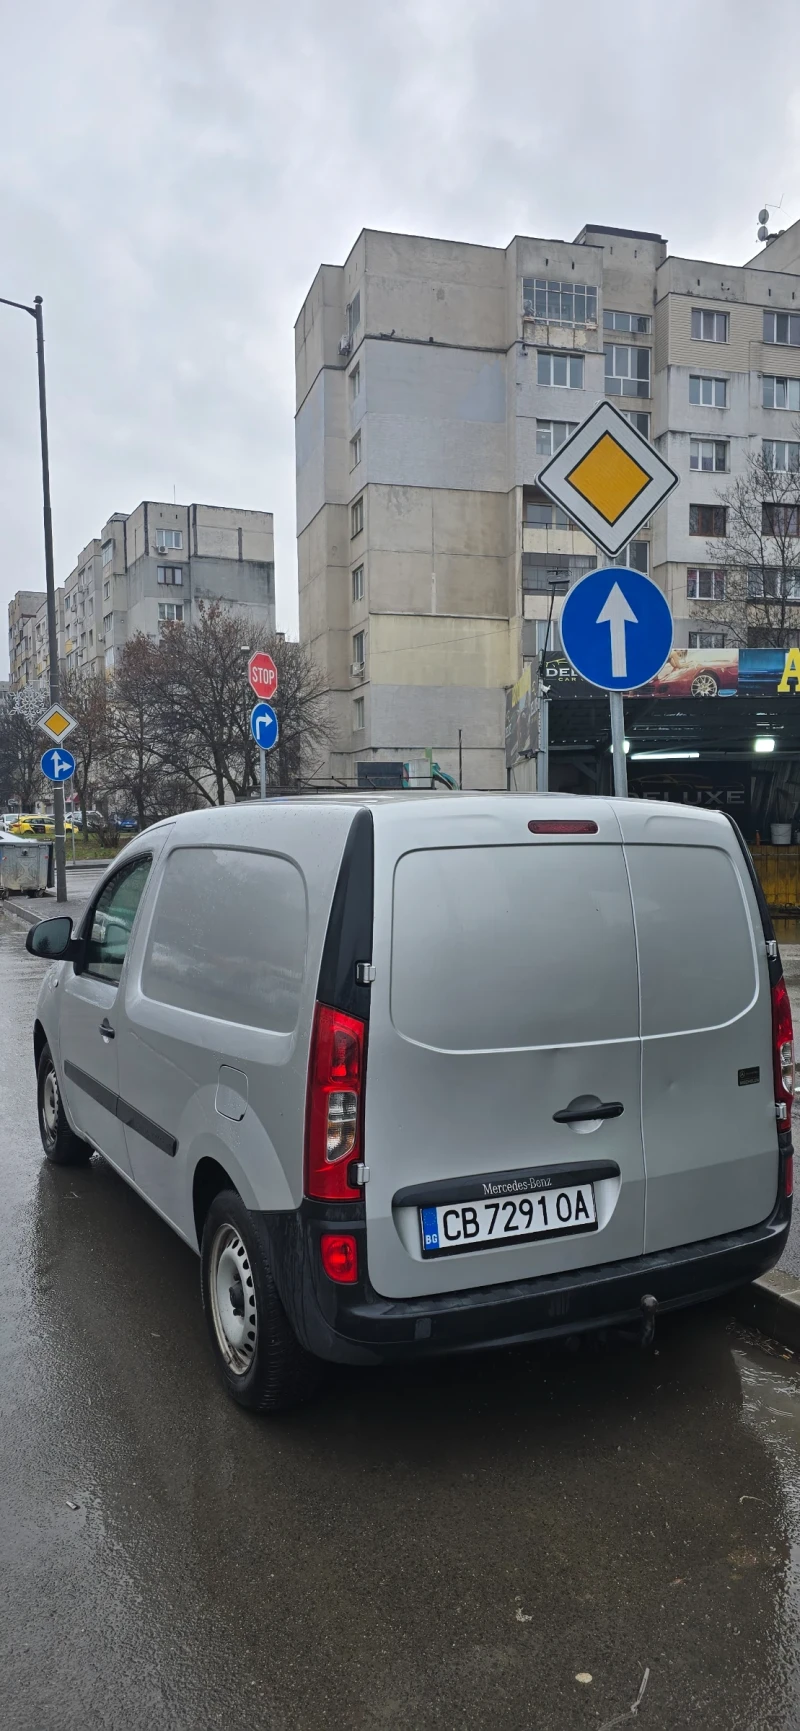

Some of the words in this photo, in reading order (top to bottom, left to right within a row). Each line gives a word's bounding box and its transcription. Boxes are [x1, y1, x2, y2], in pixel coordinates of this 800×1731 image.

[252, 666, 275, 685] STOP
[546, 668, 578, 677] DEL
[482, 1177, 553, 1195] Mercedes-Benz
[443, 1207, 480, 1241] CB
[484, 1195, 549, 1235] 7291
[556, 1190, 590, 1222] OA
[425, 1233, 438, 1245] BG
